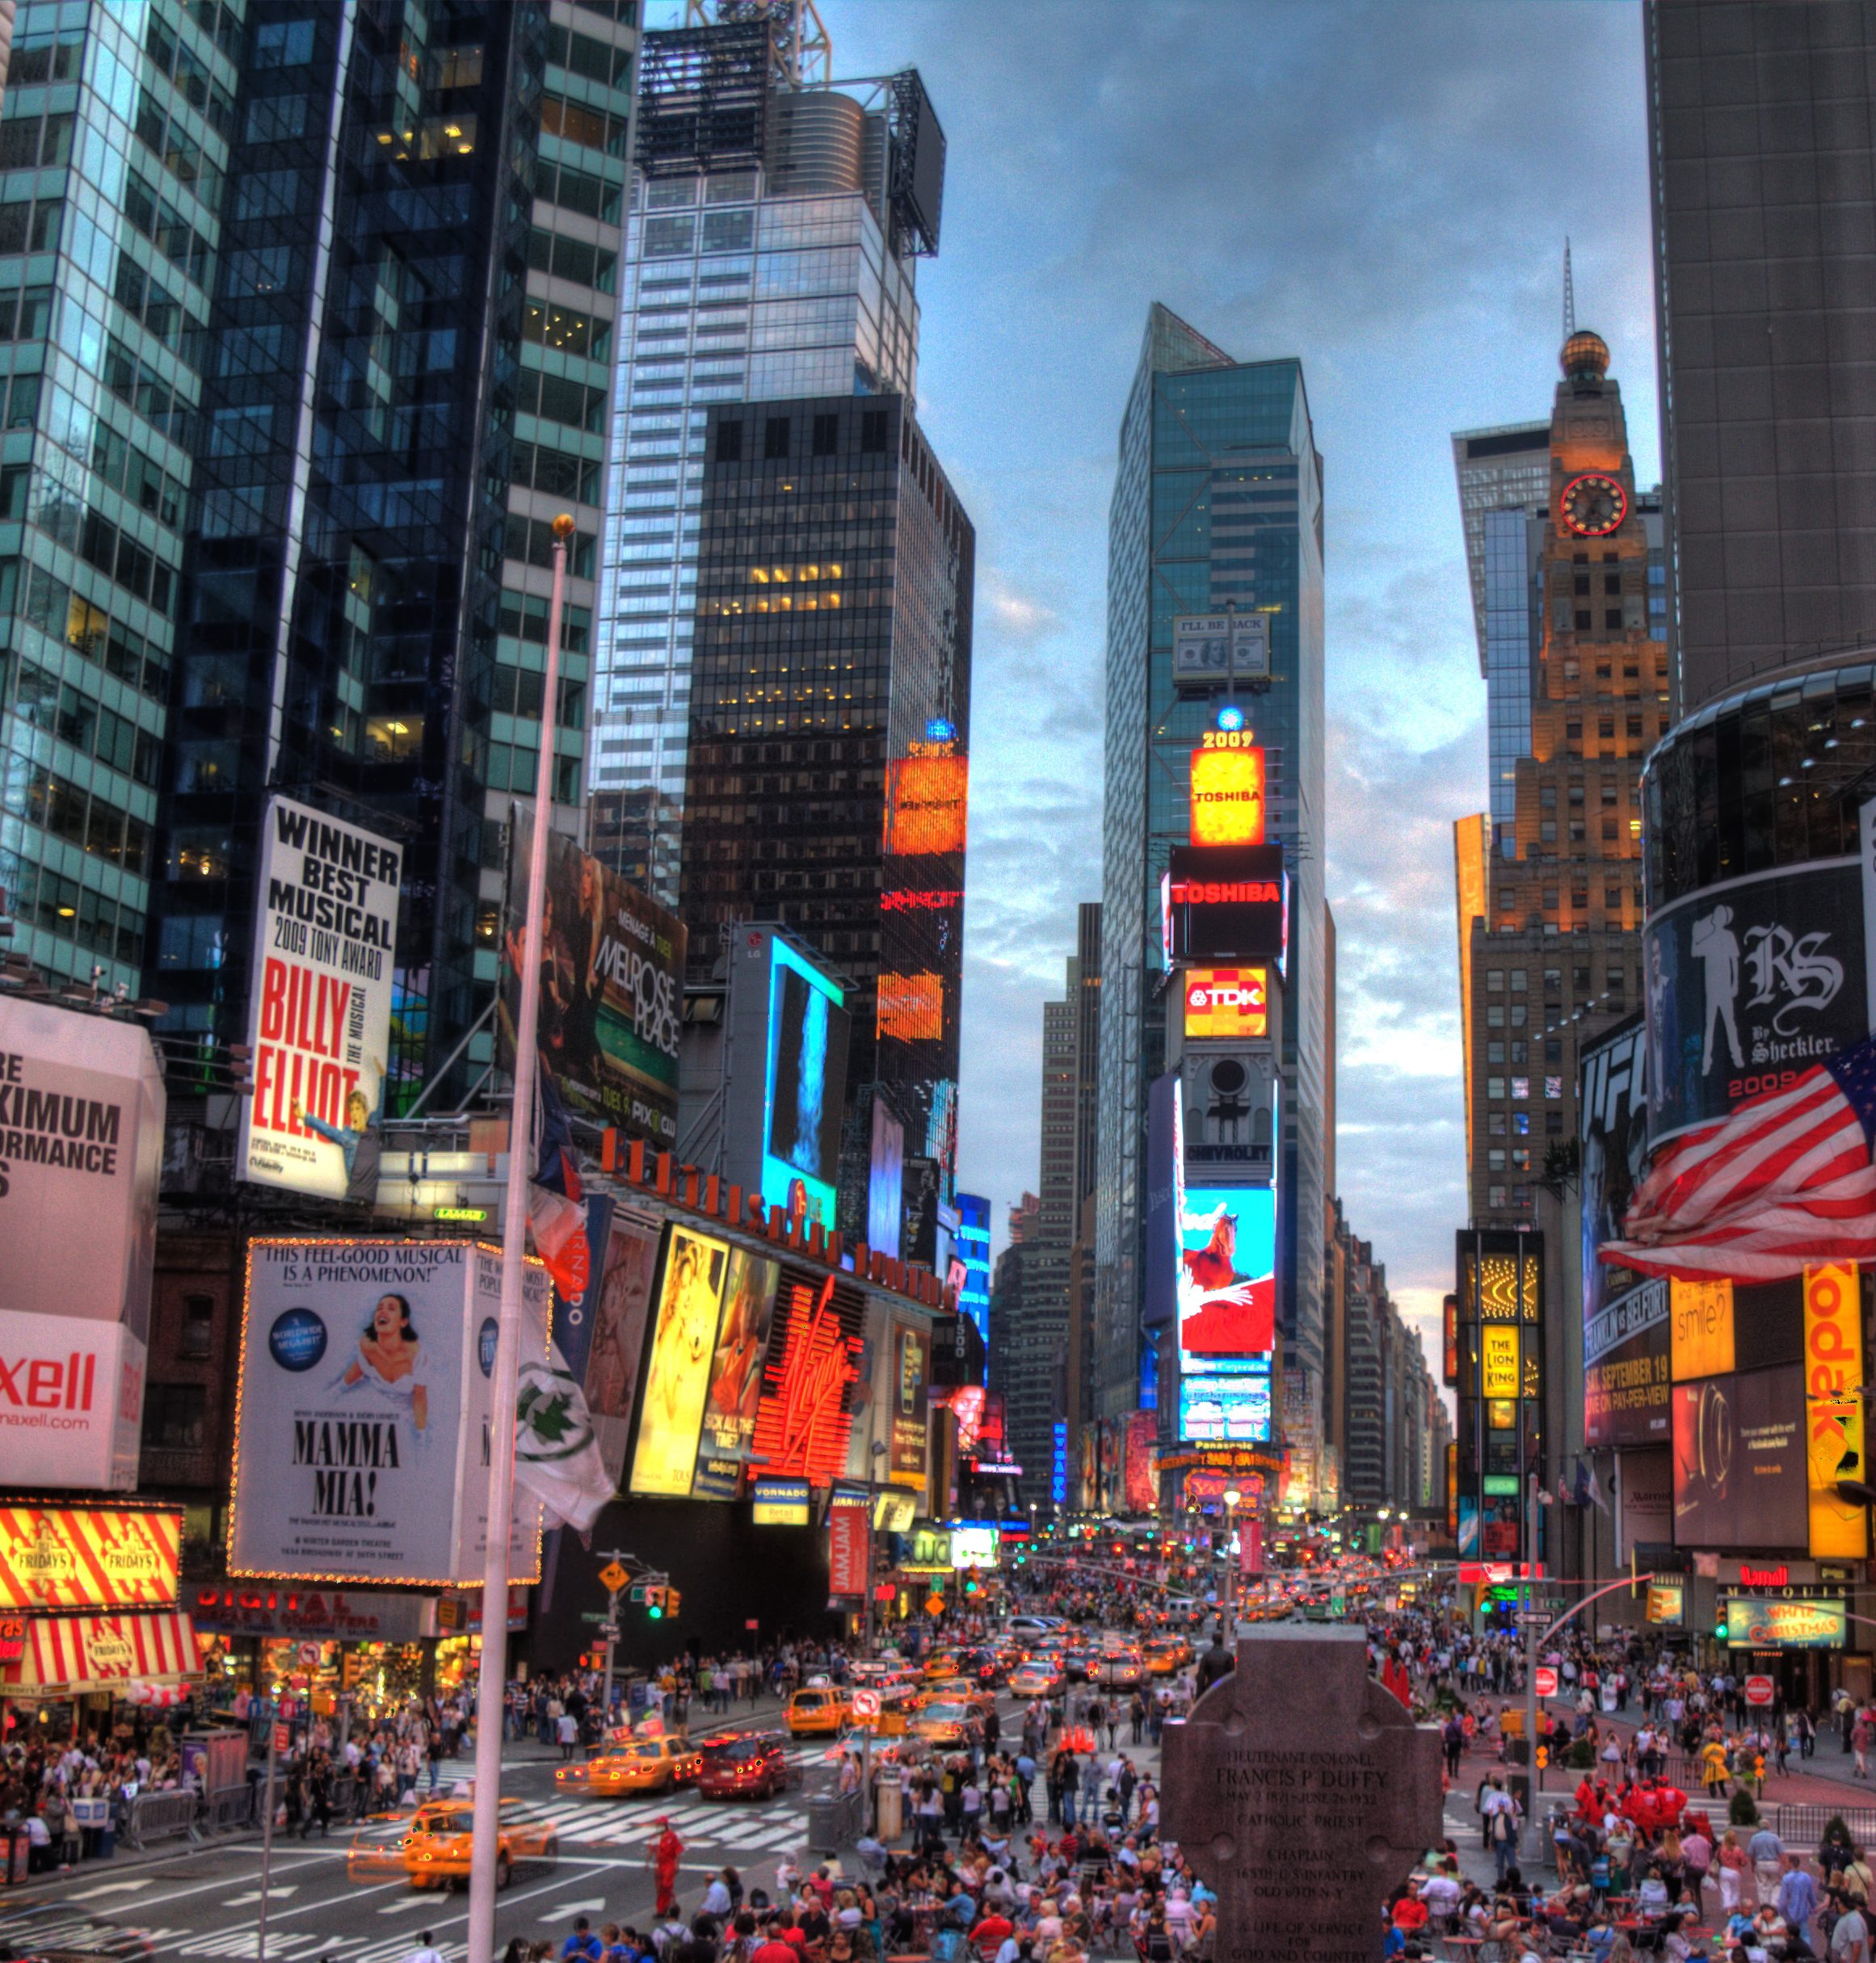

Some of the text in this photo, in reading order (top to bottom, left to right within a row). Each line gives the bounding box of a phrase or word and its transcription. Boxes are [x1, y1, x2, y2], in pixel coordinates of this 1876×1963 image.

[1181, 621, 1205, 632] I'LL
[1209, 620, 1225, 630] BE
[1202, 731, 1253, 748] 2009
[1195, 791, 1260, 803] TOSHIBA
[276, 805, 399, 888] WINNER
[302, 855, 370, 907] BEST
[1171, 882, 1281, 904] TOSHIBA
[268, 877, 393, 951] MUSICAL
[274, 916, 381, 981] 2009 TONY AWARD
[747, 950, 761, 959] LG
[595, 935, 675, 1019] MELROSE
[1206, 988, 1261, 1006] TDK
[259, 956, 351, 1061] BILLY
[347, 986, 367, 1065] THE MUSICAL
[633, 997, 680, 1059] PLACE
[253, 1042, 360, 1145] ELLIOT
[1187, 1145, 1270, 1161] CHEVROLET
[304, 1247, 389, 1265] FEEL-GOOD
[394, 1248, 464, 1264] MUSICAL
[284, 1265, 438, 1284] IS A PHENOMENON!"
[1586, 1307, 1617, 1357] FRANKLIN
[1626, 1281, 1668, 1330] BELFORT
[1677, 1293, 1727, 1342] smile?
[1491, 1340, 1511, 1350] THE
[1487, 1352, 1514, 1368] LION
[0, 1352, 95, 1411] xell
[1487, 1371, 1515, 1388] KING
[1601, 1357, 1651, 1390] SEPTEMBER
[1655, 1354, 1668, 1383] 19
[1600, 1393, 1612, 1412] ON
[1613, 1384, 1669, 1410] PAY-PER-VIEW
[723, 1414, 738, 1433] ALL
[738, 1416, 755, 1435] THE
[292, 1420, 400, 1469] MAMMA
[1194, 1441, 1254, 1450] Panasonic
[312, 1470, 377, 1517] MIA!
[755, 1487, 808, 1498] VORNADO
[1630, 1490, 1671, 1503] Marrio
[768, 1507, 793, 1517] Retail
[834, 1515, 851, 1591] JAMJAM
[197, 1588, 351, 1614] DIGITAL
[1727, 1586, 1847, 1599] MARQUIS
[1765, 1601, 1816, 1620] WHITE
[1748, 1616, 1839, 1643] CHRISTMAS
[1226, 1751, 1374, 1766] LIEUTENANT COLONEL
[1216, 1768, 1295, 1787] FRANCIS
[1321, 1770, 1389, 1789] DUFFY
[1226, 1791, 1251, 1802] MAY
[1237, 1814, 1364, 1830] CATHOLIC PRIEST
[1267, 1848, 1334, 1861] CHAPLAIN
[1305, 1869, 1366, 1881] INFANTRY
[1253, 1885, 1281, 1898] OLD
[1253, 1922, 1281, 1934] LIFE
[1285, 1923, 1306, 1935] OF
[1309, 1923, 1365, 1936] SERVICE
[1230, 1948, 1369, 1963] GOD AND COUNTRY
